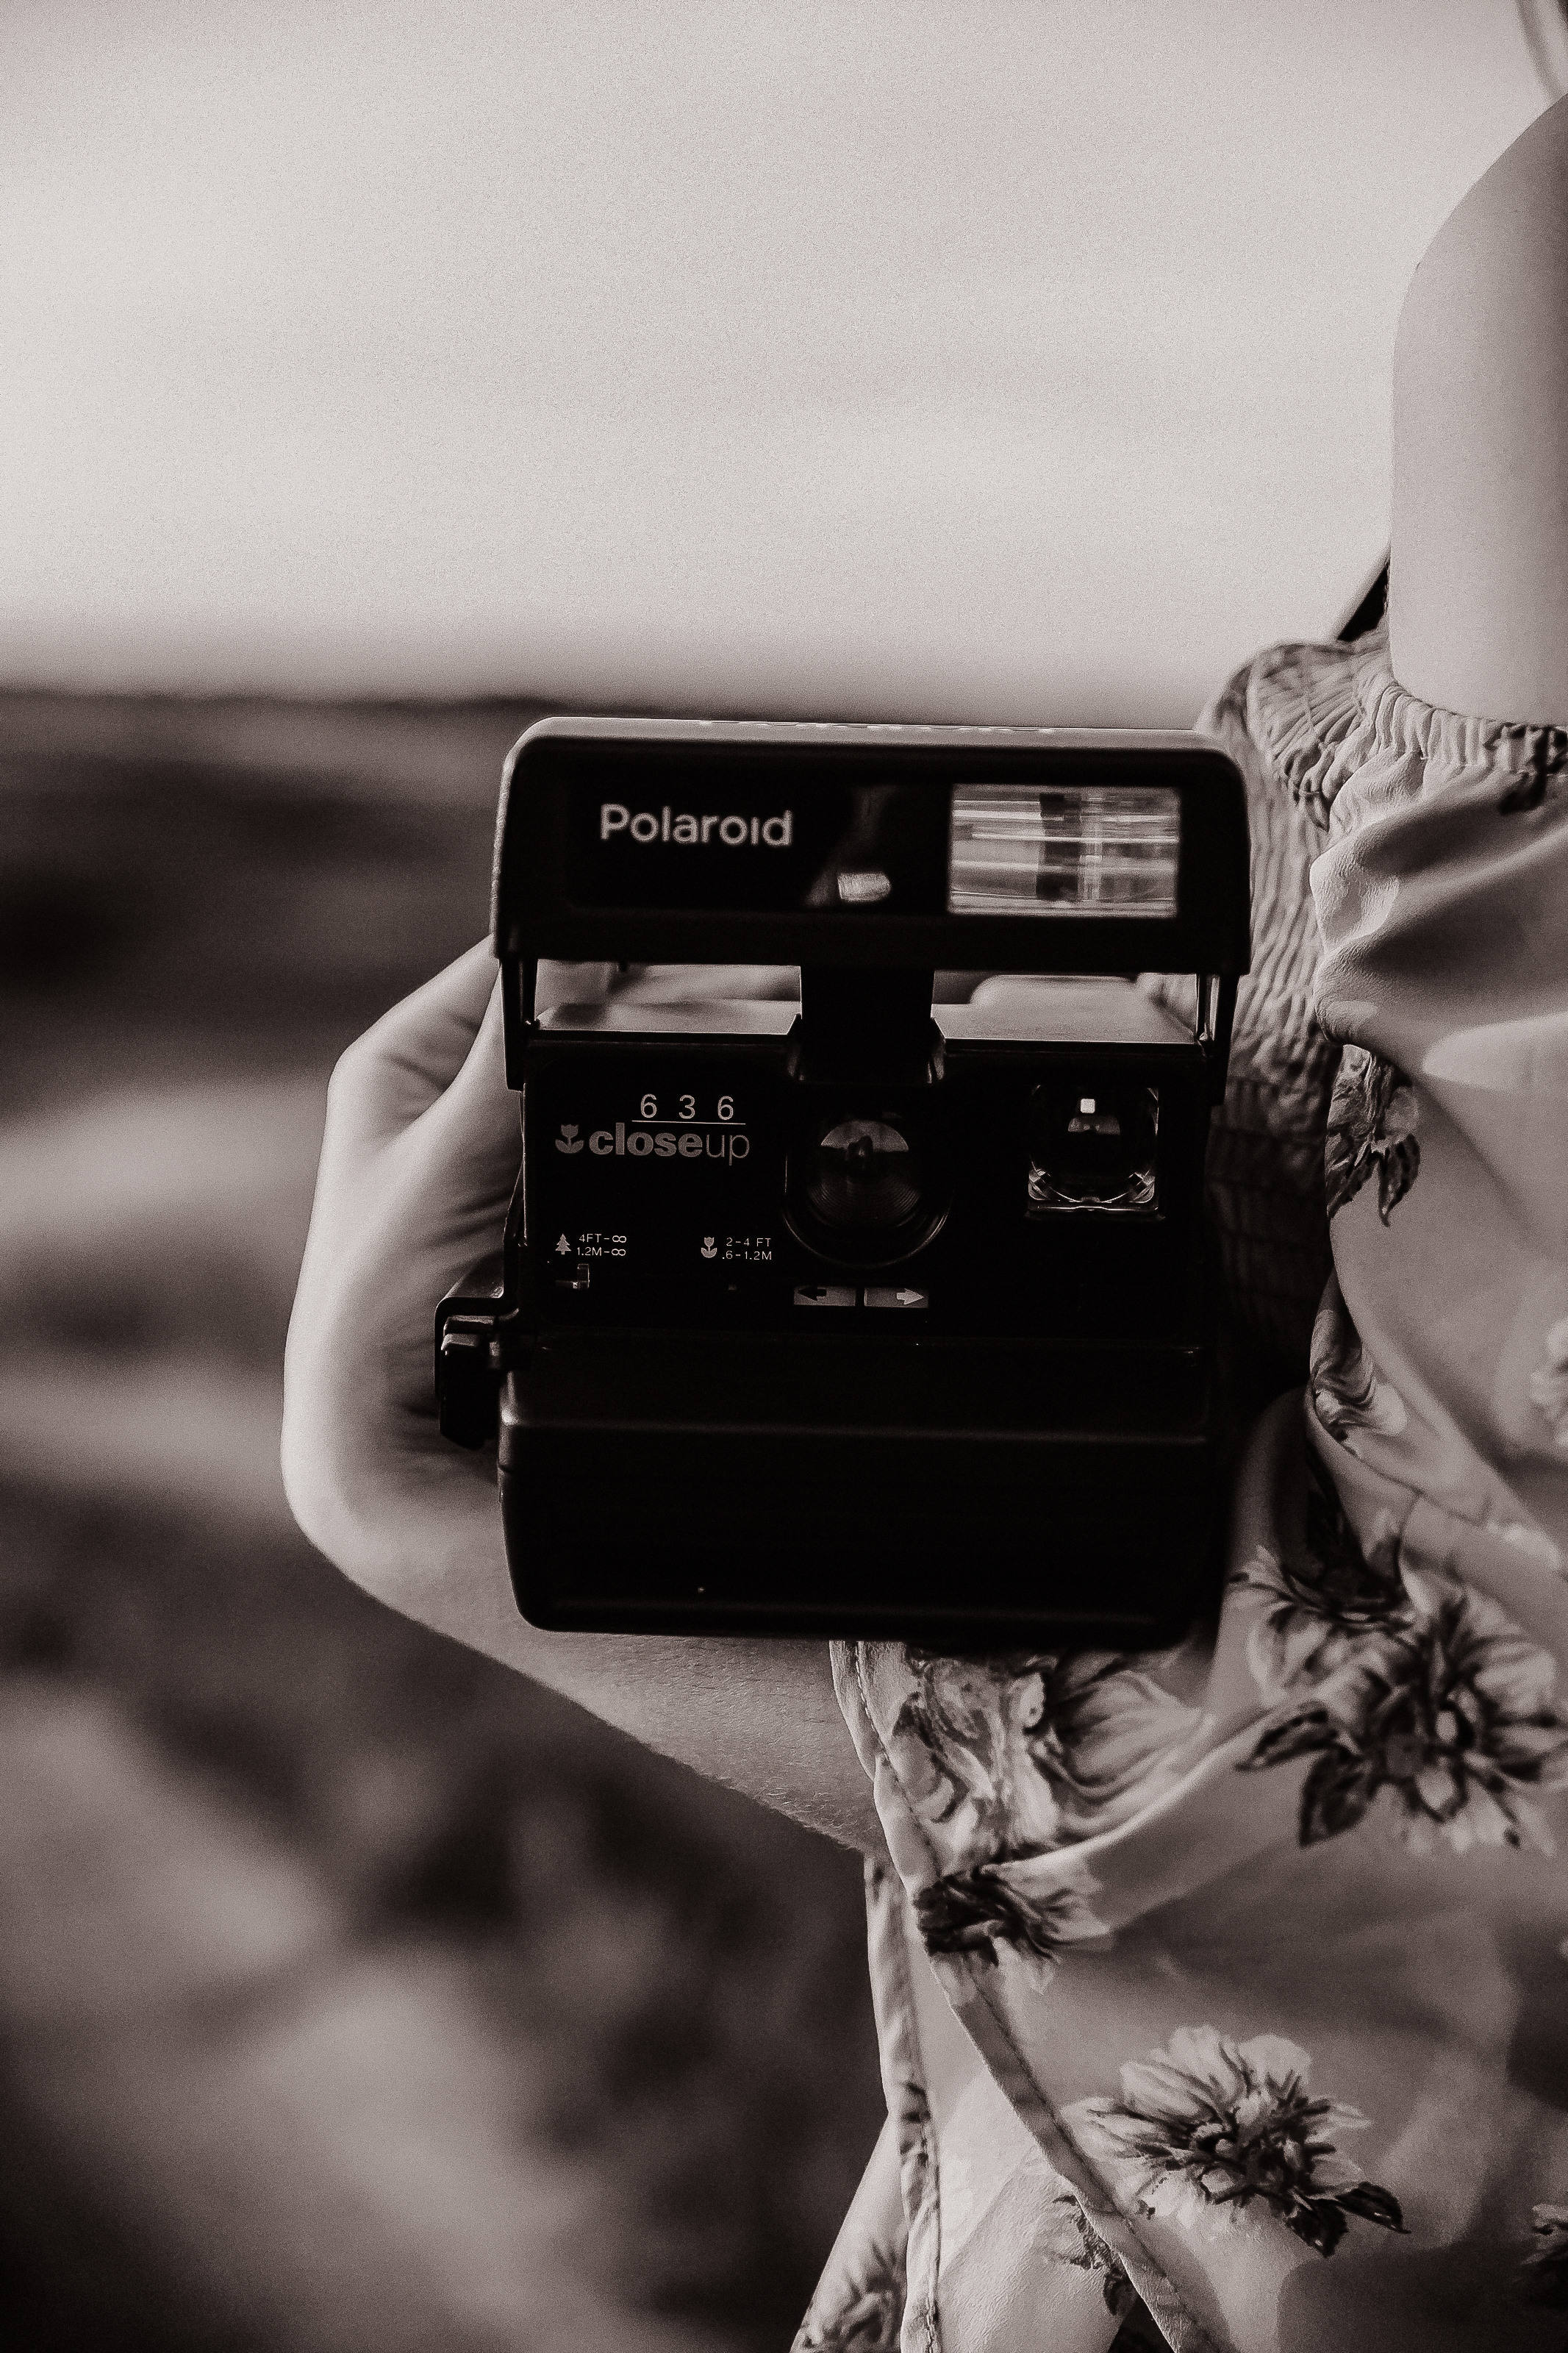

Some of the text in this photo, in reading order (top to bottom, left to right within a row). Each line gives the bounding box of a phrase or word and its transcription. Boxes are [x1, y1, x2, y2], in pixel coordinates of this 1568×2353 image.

[599, 802, 794, 847] Polaroid
[588, 1121, 751, 1167] closeup
[725, 1237, 772, 1248] 2-4 FT
